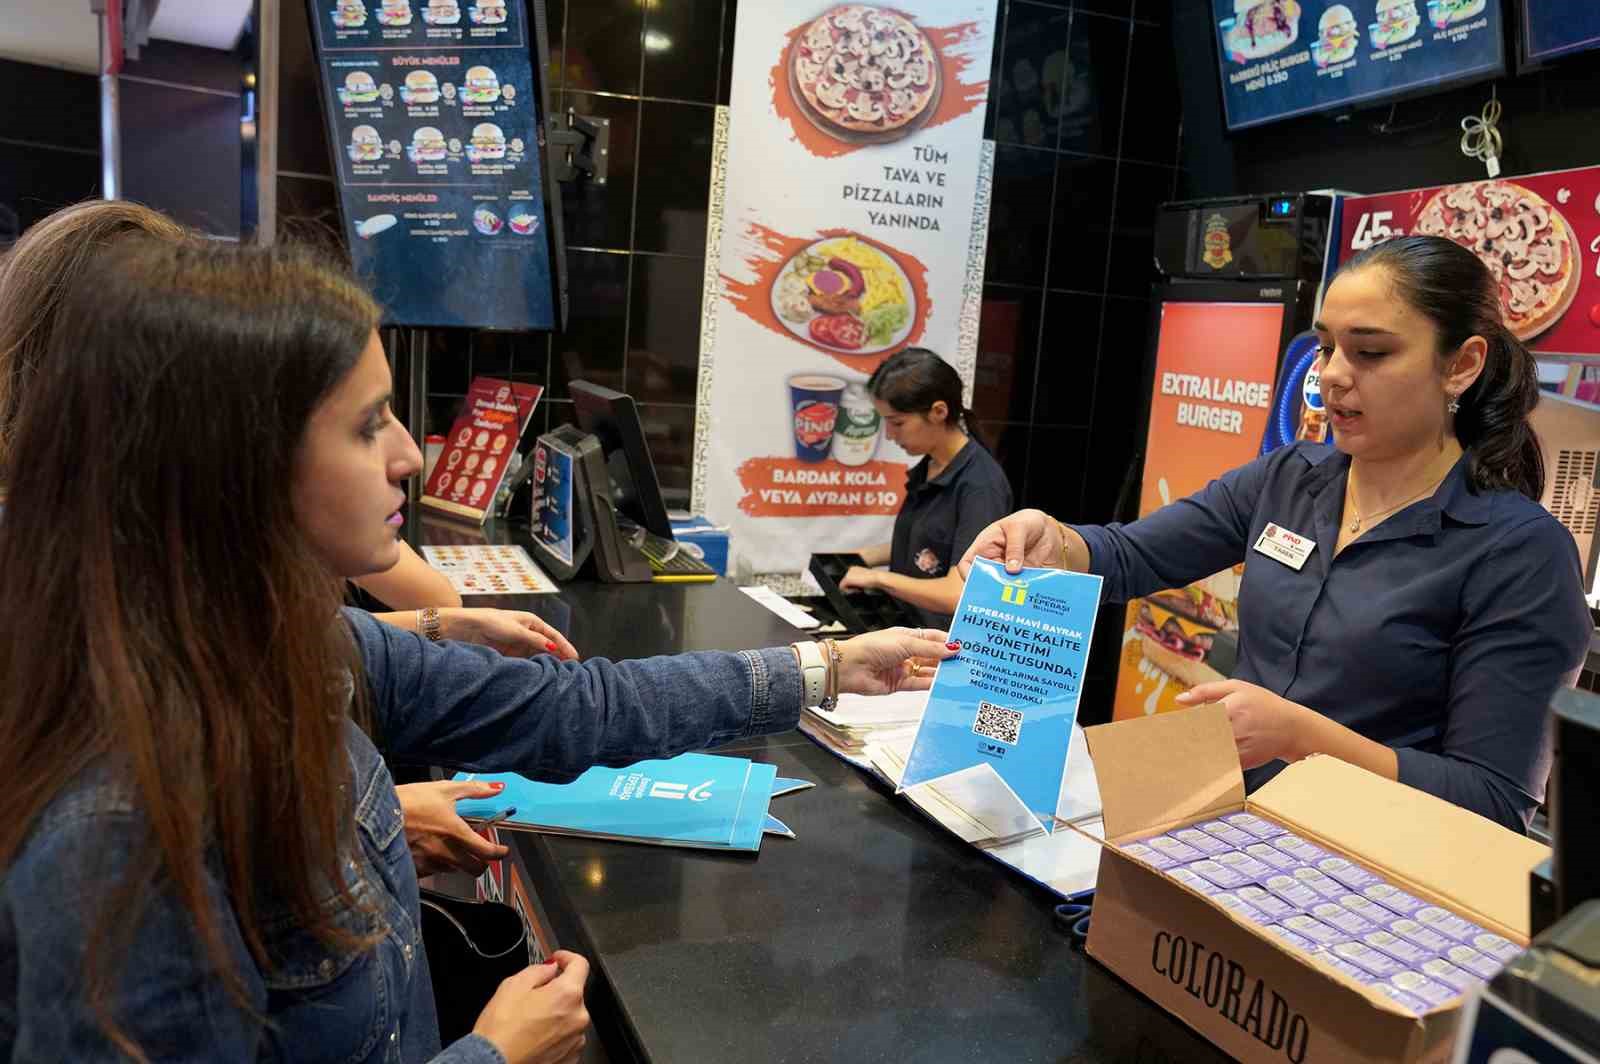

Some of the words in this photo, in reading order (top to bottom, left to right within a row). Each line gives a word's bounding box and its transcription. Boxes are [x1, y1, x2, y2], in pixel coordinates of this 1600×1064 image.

[914, 145, 948, 164] TÜM
[883, 167, 921, 184] TAVA
[926, 172, 946, 186] VE
[843, 183, 943, 208] PİZZALARIN
[868, 211, 940, 231] YANINDA
[1161, 372, 1212, 400] EXTRA
[1213, 377, 1271, 409] LARGE
[1176, 403, 1242, 434] BURGER
[771, 468, 840, 484] BARDAK
[845, 472, 886, 486] KOLA
[760, 489, 802, 505] VEYA
[806, 491, 862, 506] AYRAN
[962, 614, 1011, 635] HİJYEN
[1013, 627, 1030, 639] VE
[1034, 630, 1080, 651] KALİTE
[1042, 621, 1082, 640] BAYRAK
[987, 633, 1052, 658] YÖNETİMİ
[1010, 680, 1048, 695] DUYARLI
[1010, 691, 1044, 704] ODAKLI
[1152, 930, 1309, 1064] COLORADO
